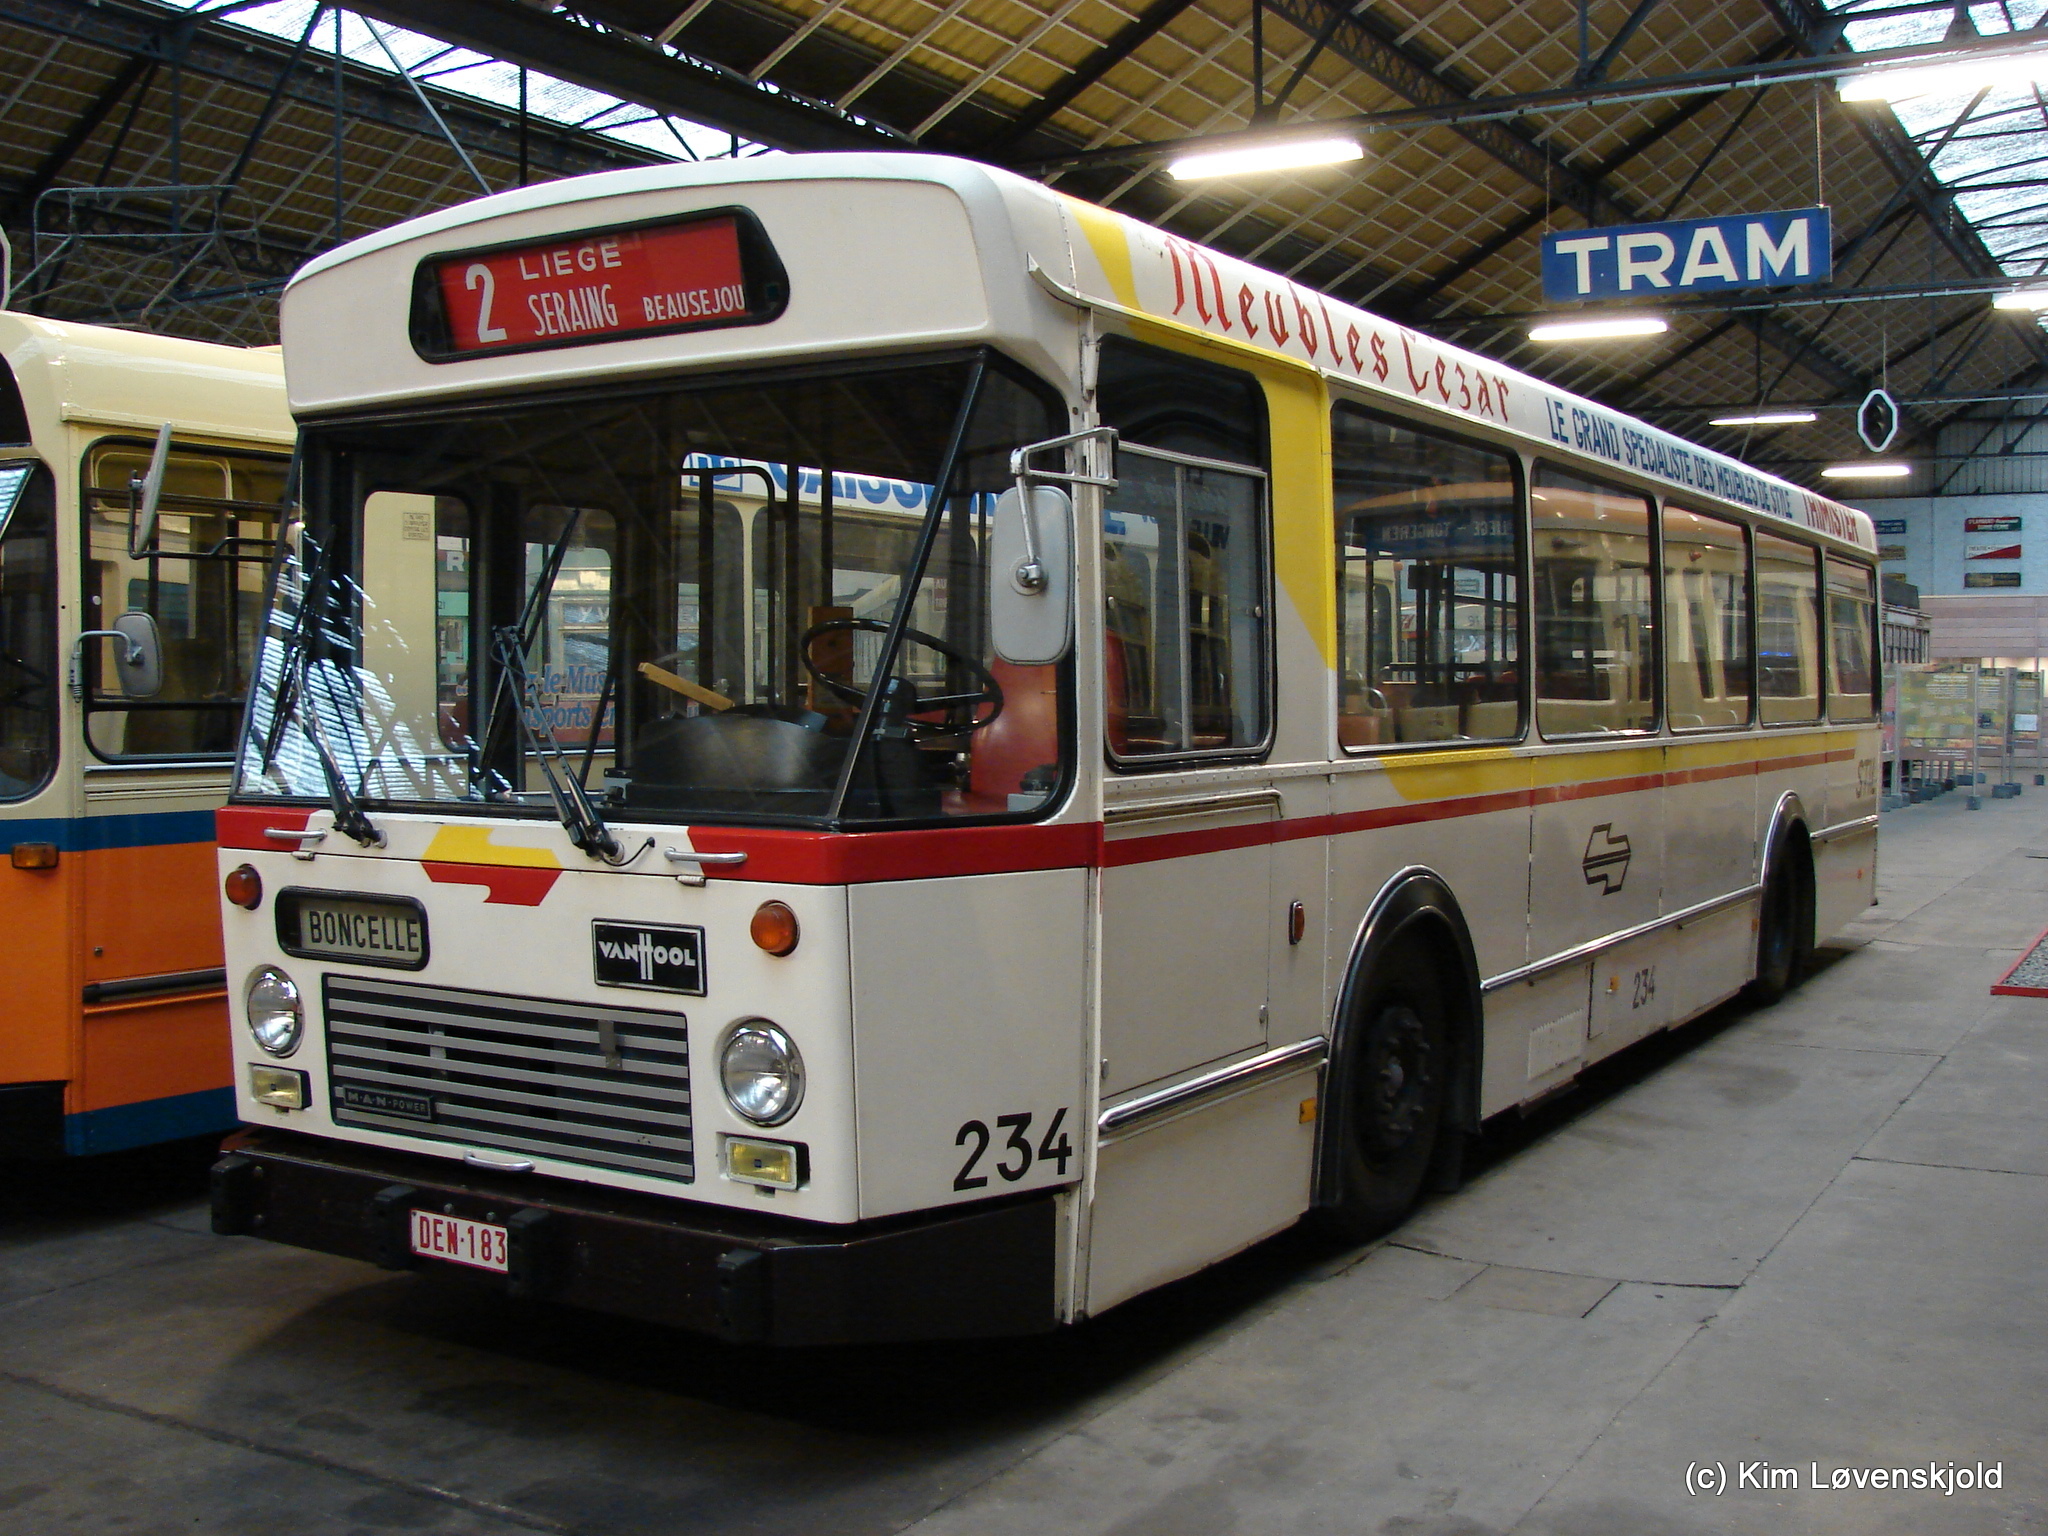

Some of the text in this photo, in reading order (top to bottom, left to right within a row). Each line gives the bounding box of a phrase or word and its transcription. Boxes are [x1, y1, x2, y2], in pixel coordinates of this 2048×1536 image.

[518, 243, 622, 281] LIEGE
[1555, 218, 1809, 294] TRAM
[465, 263, 507, 343] 2
[527, 284, 746, 336] SERAING BEAUSEJOU
[1164, 235, 1389, 384] Meubles
[1545, 397, 1569, 444] LE
[1572, 408, 1620, 461] GRAND
[1622, 427, 1693, 485] SPECIALISTE
[1693, 455, 1715, 493] DES
[1715, 463, 1758, 507] MEUBLES
[1757, 480, 1771, 511] DE
[309, 911, 419, 952] BONCELLE
[1632, 965, 1656, 1009] 234
[953, 1107, 1072, 1192] 234
